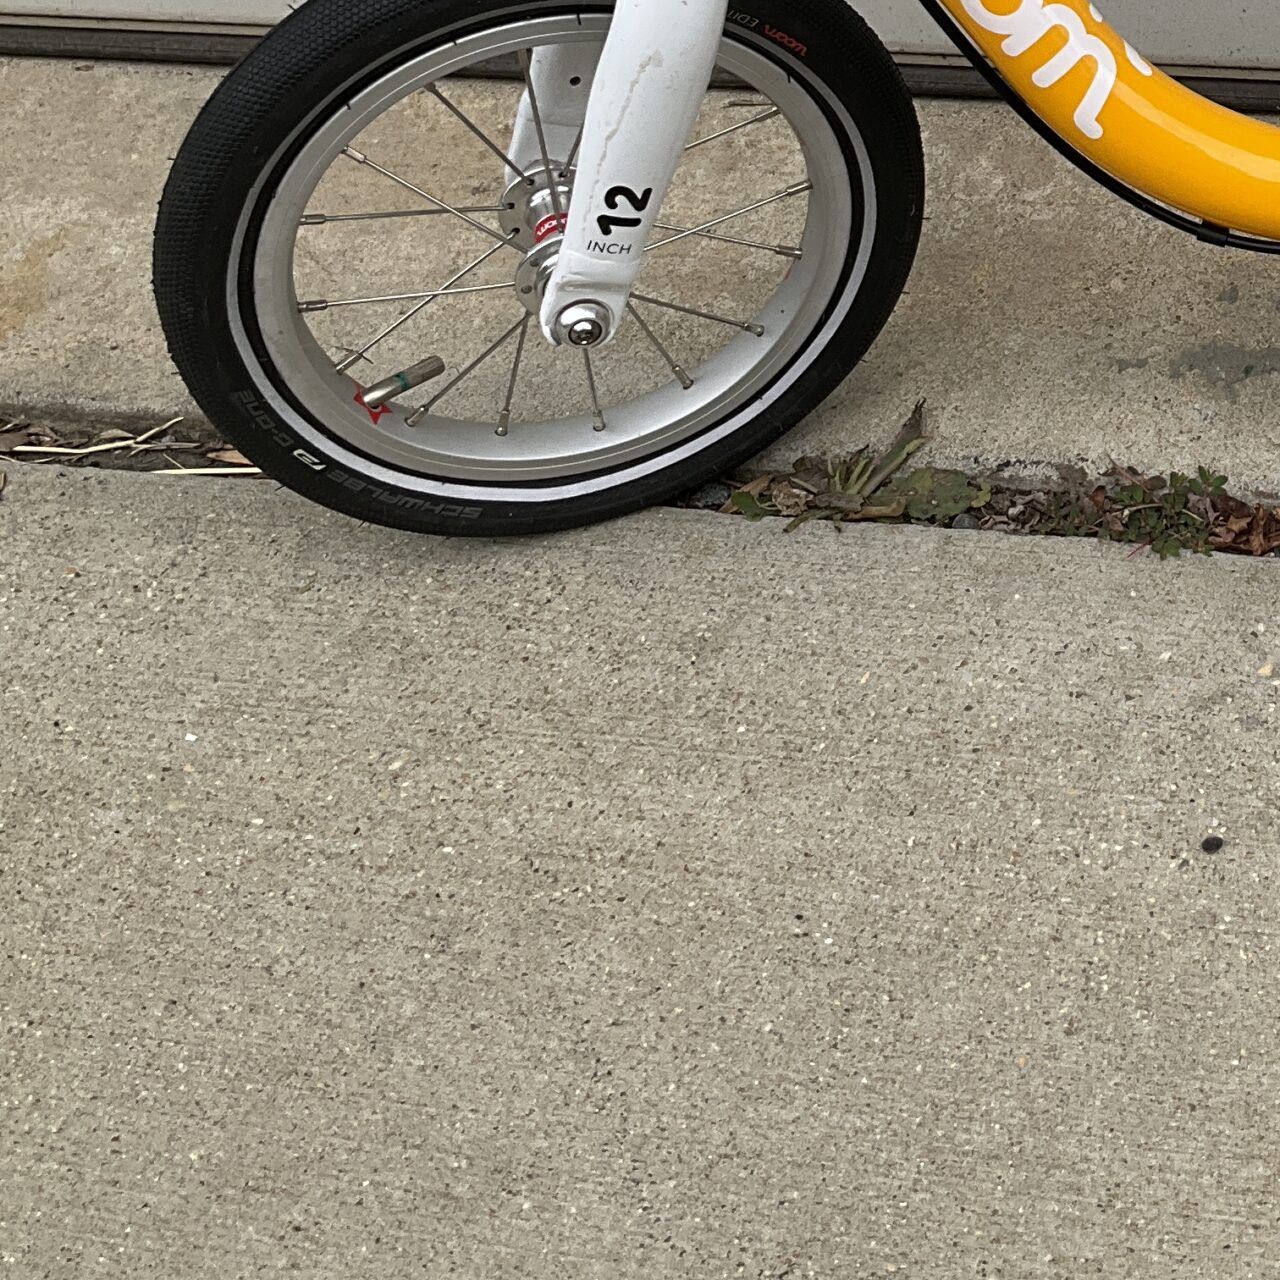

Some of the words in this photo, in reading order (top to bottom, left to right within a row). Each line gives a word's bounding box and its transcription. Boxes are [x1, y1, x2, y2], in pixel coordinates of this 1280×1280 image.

[763, 24, 808, 57] woom
[596, 185, 653, 236] 12
[586, 240, 632, 254] INCH
[327, 471, 486, 520] SCHWALBE
